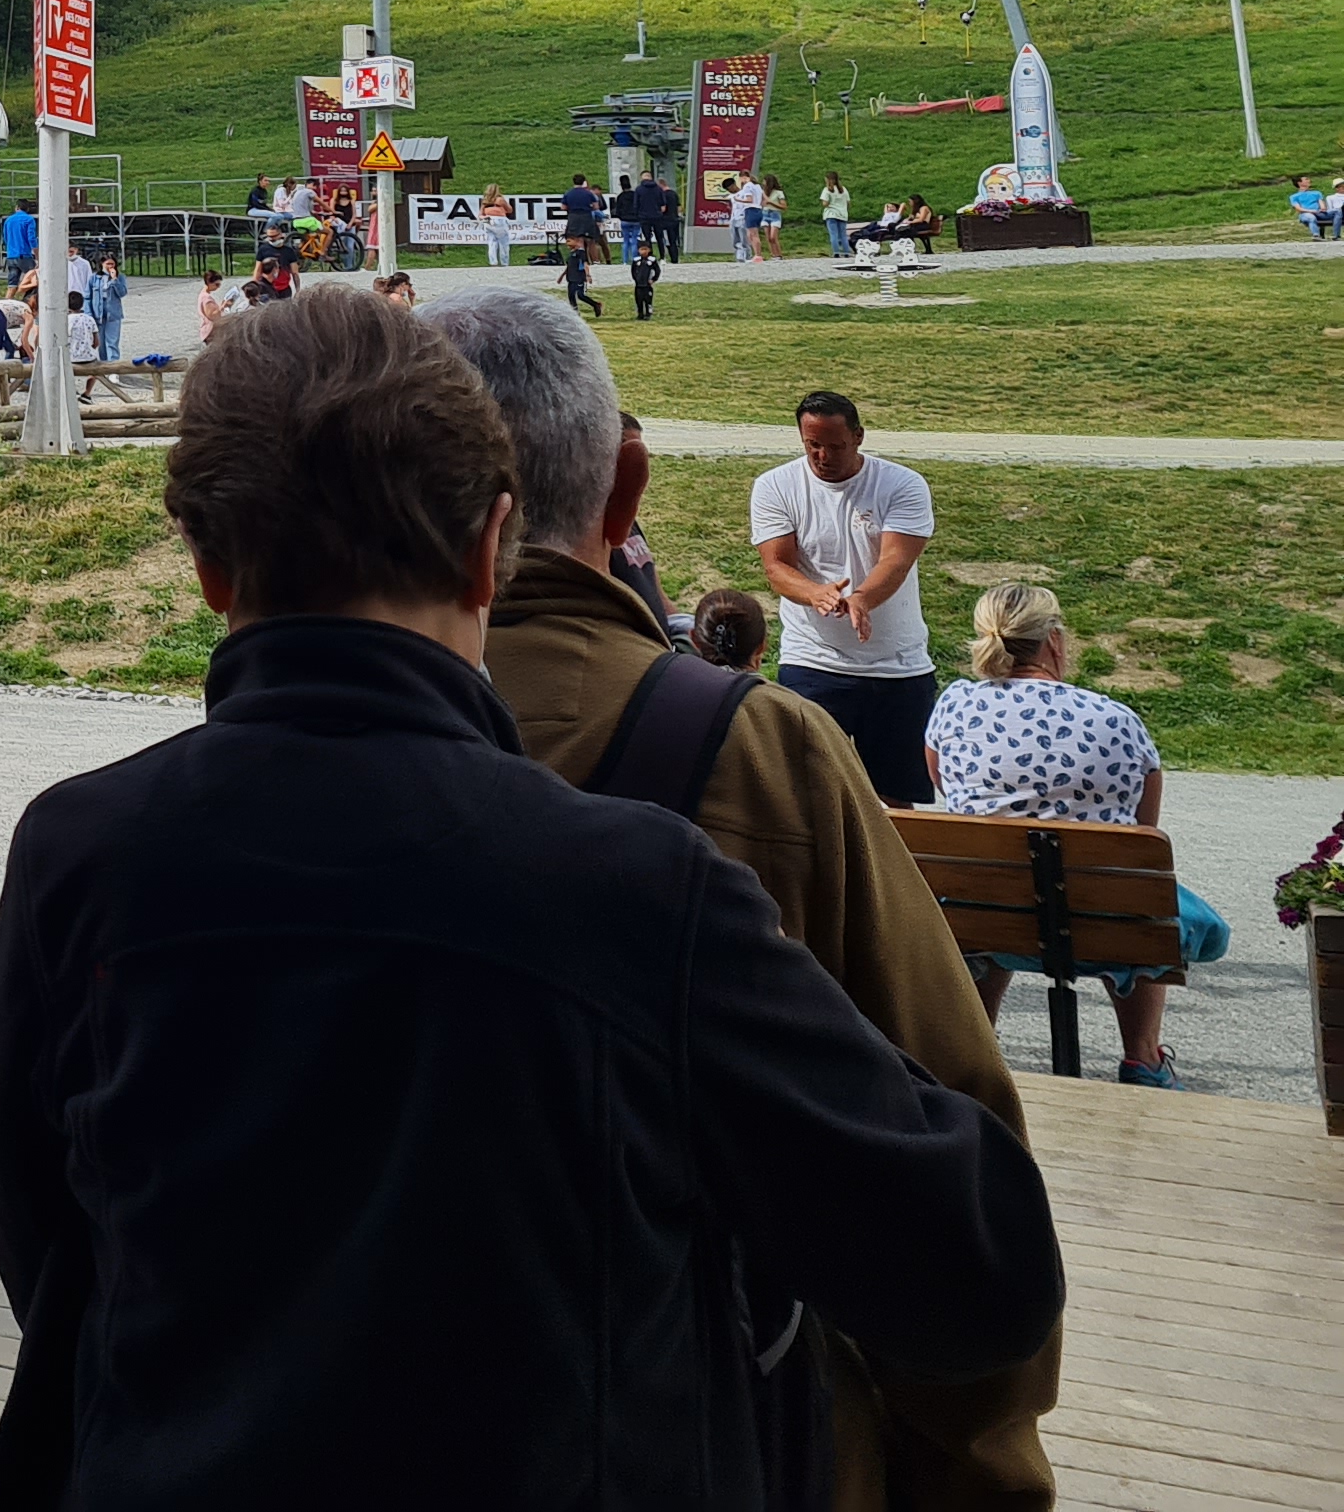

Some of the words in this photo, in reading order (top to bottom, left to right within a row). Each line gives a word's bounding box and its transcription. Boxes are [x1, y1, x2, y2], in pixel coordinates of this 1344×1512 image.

[704, 71, 758, 86] Espace
[711, 90, 733, 100] des
[309, 110, 354, 122] Espace
[703, 104, 755, 117] Etoiles
[336, 126, 355, 135] des
[313, 136, 357, 148] Etoiles
[418, 221, 455, 231] Enfants
[458, 221, 471, 231] de
[418, 232, 454, 241] Famille
